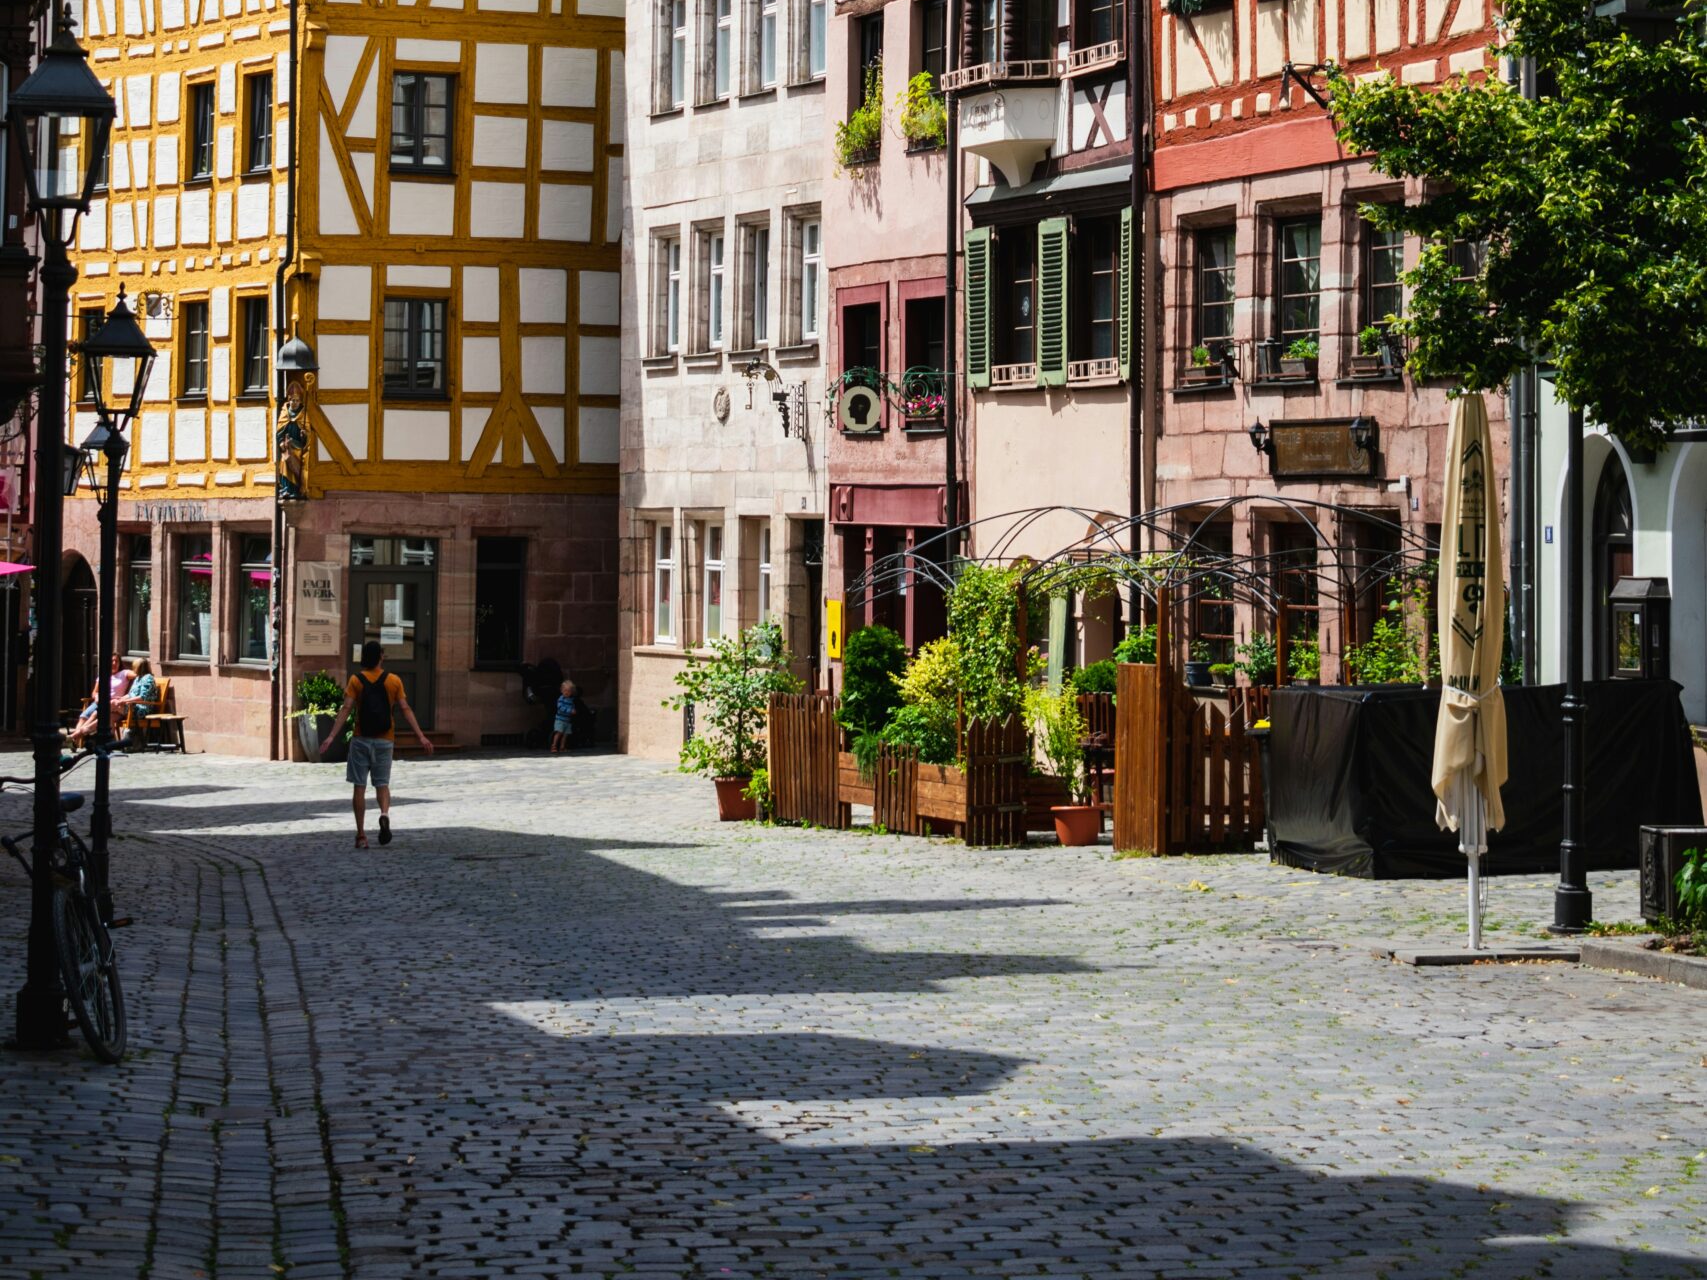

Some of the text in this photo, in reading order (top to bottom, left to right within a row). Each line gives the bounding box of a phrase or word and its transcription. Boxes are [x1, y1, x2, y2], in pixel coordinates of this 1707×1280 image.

[135, 503, 206, 523] FACHWERK
[303, 580, 331, 589] FACH
[303, 589, 335, 598] WERK
